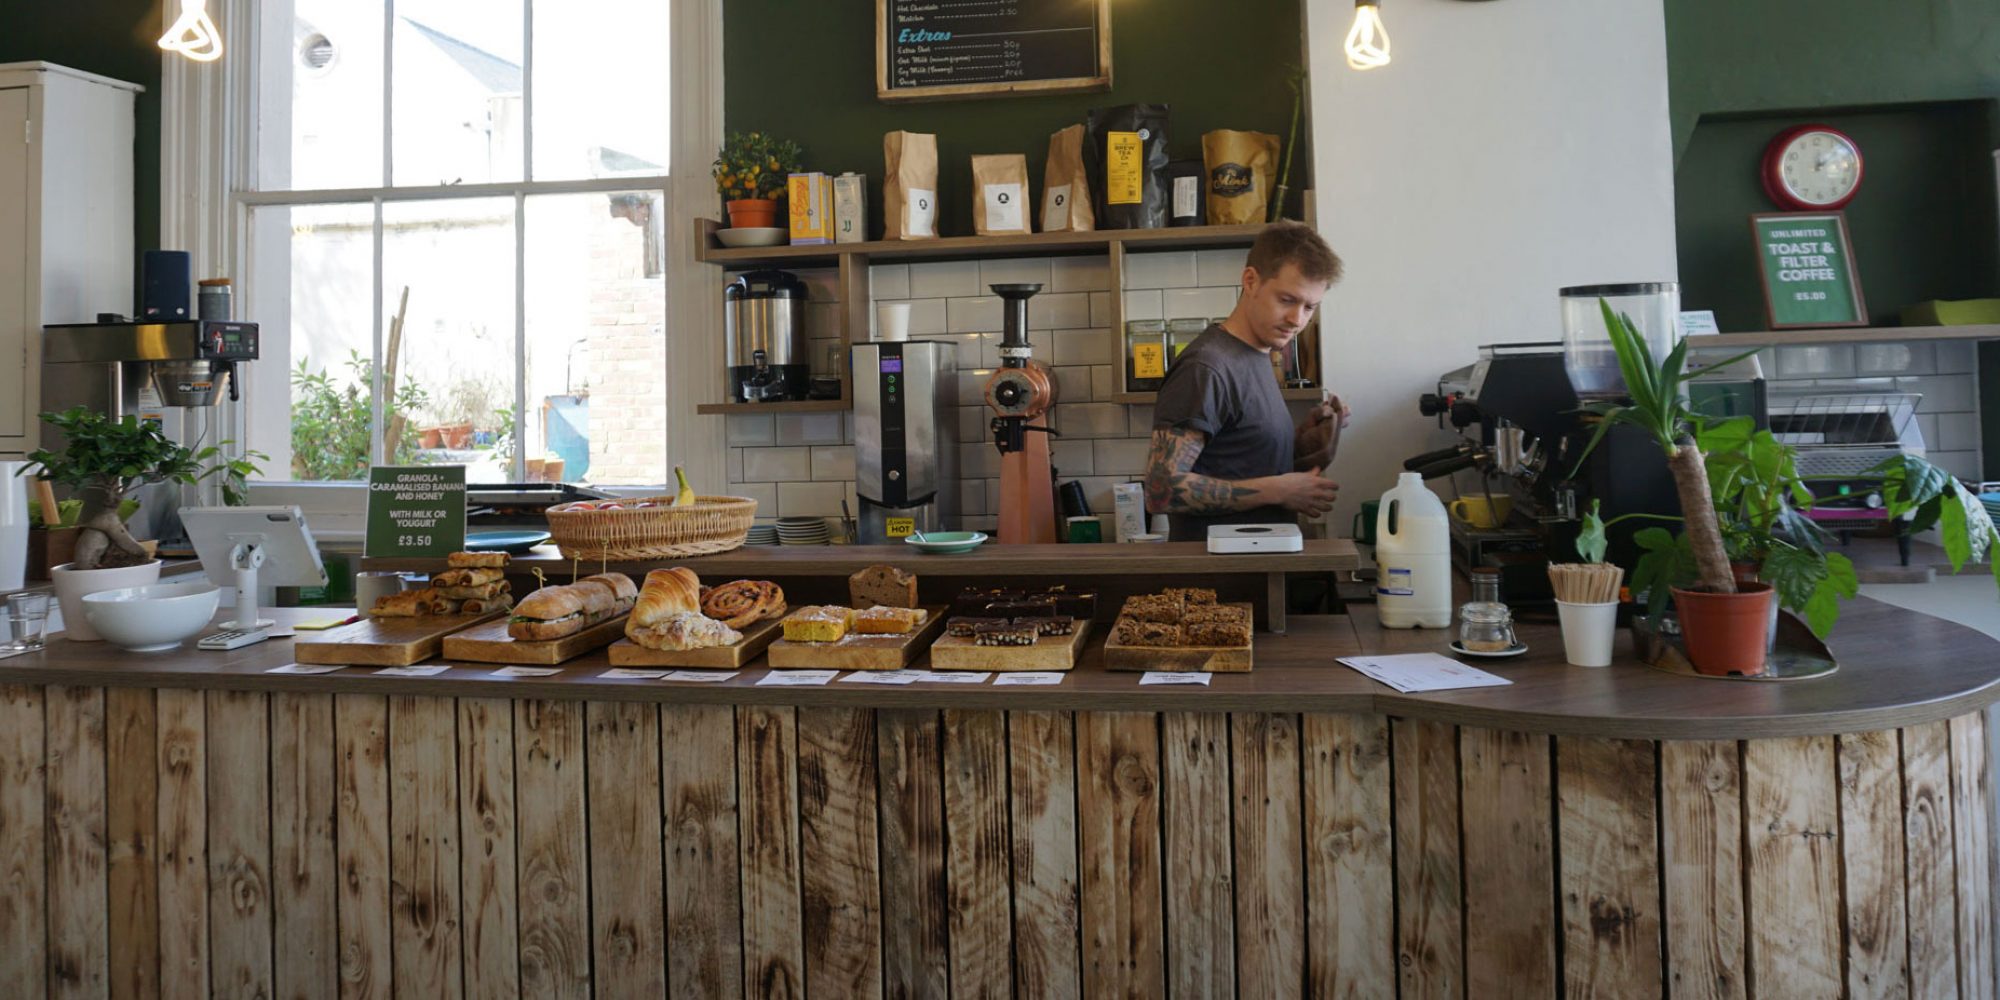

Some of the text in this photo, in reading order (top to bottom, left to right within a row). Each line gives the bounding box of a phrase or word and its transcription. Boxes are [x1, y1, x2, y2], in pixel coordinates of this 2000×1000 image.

[898, 28, 951, 43] Extras
[1771, 229, 1826, 238] UNLIMITED
[1768, 242, 1835, 255] TOAST &
[1780, 256, 1829, 268] FILTER
[1780, 269, 1835, 281] COFFEE
[397, 474, 438, 482] GRANOLA
[370, 482, 464, 492] CARAMALISED BANANA
[395, 492, 444, 500] AND HONEY
[389, 510, 447, 518] WITH MILK OR
[396, 519, 437, 527] YOUGURT
[891, 525, 911, 534] HOT
[398, 535, 432, 546] £3.50
